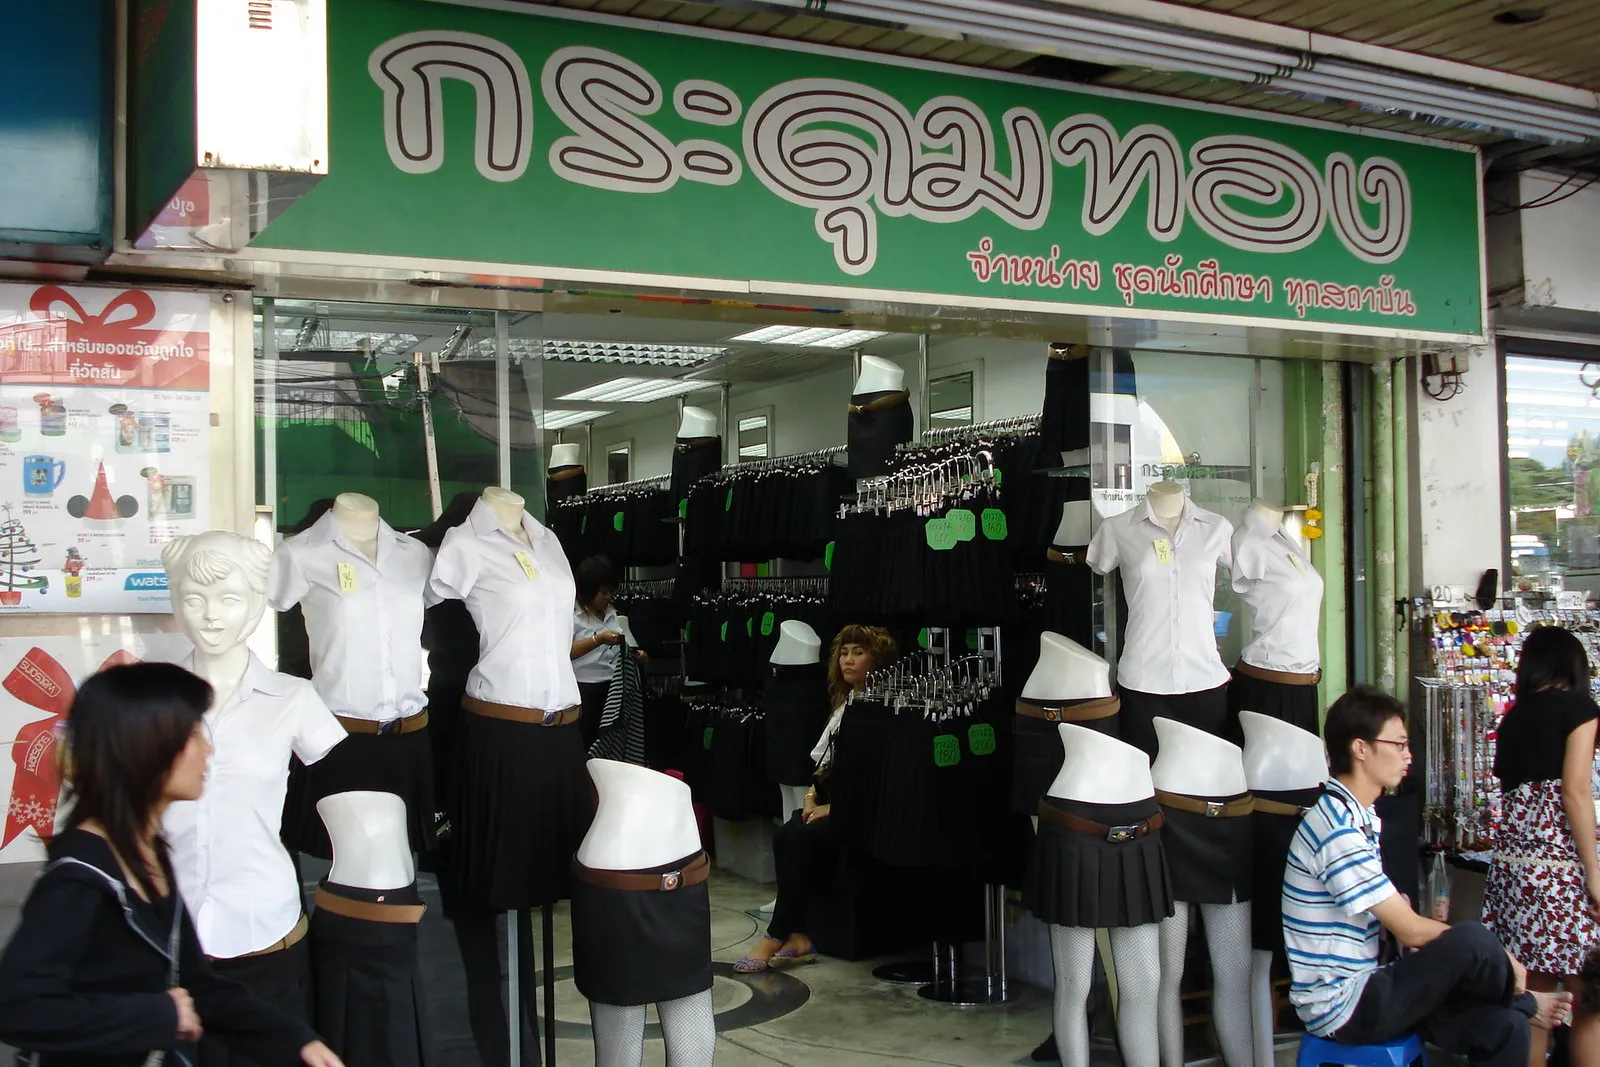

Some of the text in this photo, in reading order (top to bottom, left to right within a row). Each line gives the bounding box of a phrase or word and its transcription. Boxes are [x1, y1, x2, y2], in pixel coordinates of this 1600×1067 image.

[368, 30, 1412, 276] กระดุมทอง
[967, 236, 1417, 319] จำหน่าย ชุดนักศึกษา ทุกสถาบัน
[131, 577, 167, 587] wats
